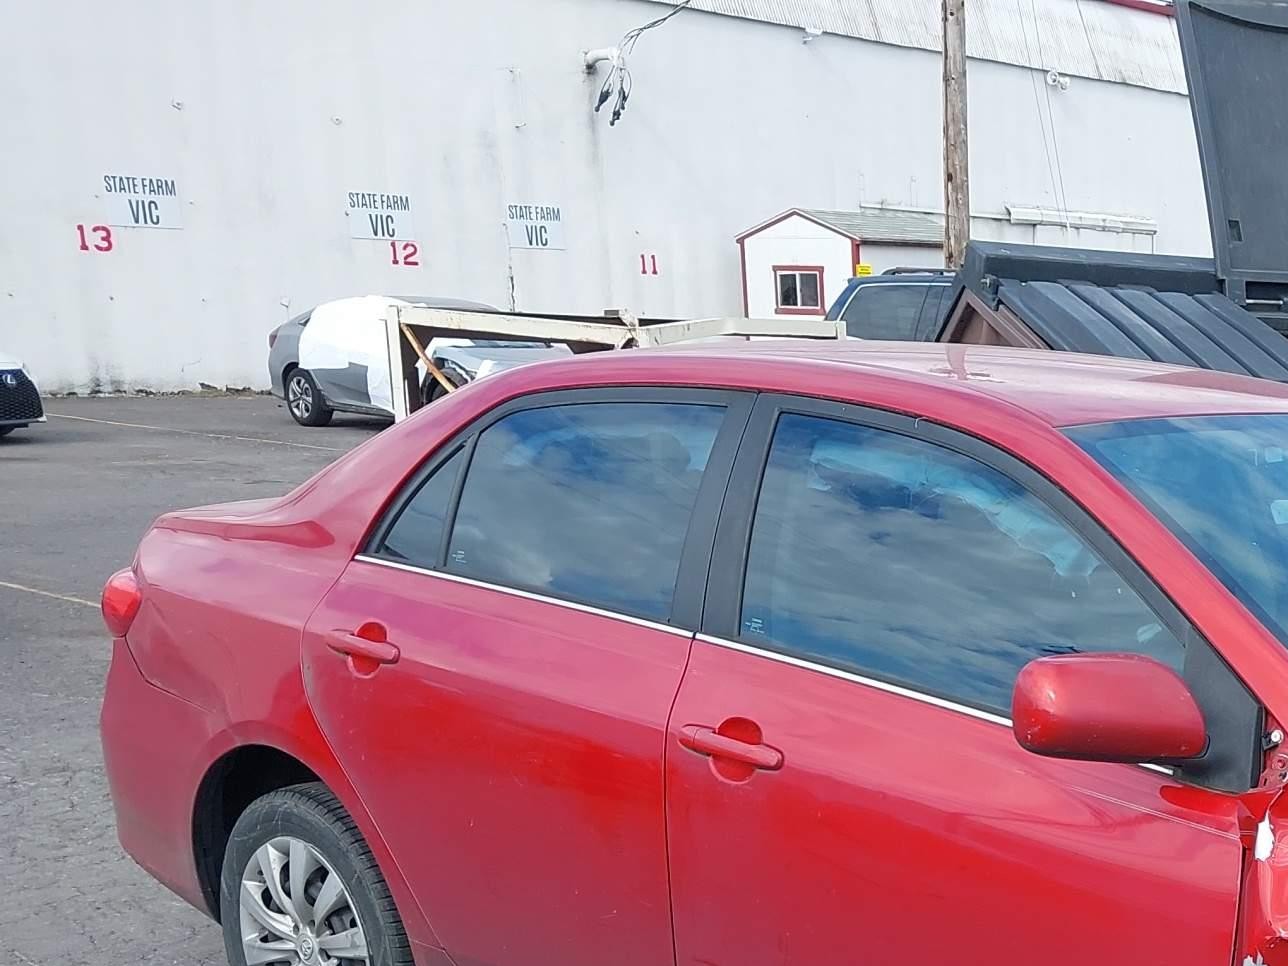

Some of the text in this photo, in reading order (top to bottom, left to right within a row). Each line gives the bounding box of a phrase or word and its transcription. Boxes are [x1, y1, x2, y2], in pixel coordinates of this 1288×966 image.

[104, 175, 176, 196] STATE FARM
[128, 199, 160, 225] VIC
[348, 192, 410, 211] STATE FARM
[508, 205, 561, 221] STATE FARM
[368, 213, 396, 238] VIC
[525, 225, 548, 246] VIC
[77, 224, 113, 252] 13
[390, 241, 419, 266] 12
[640, 254, 658, 275] 11
